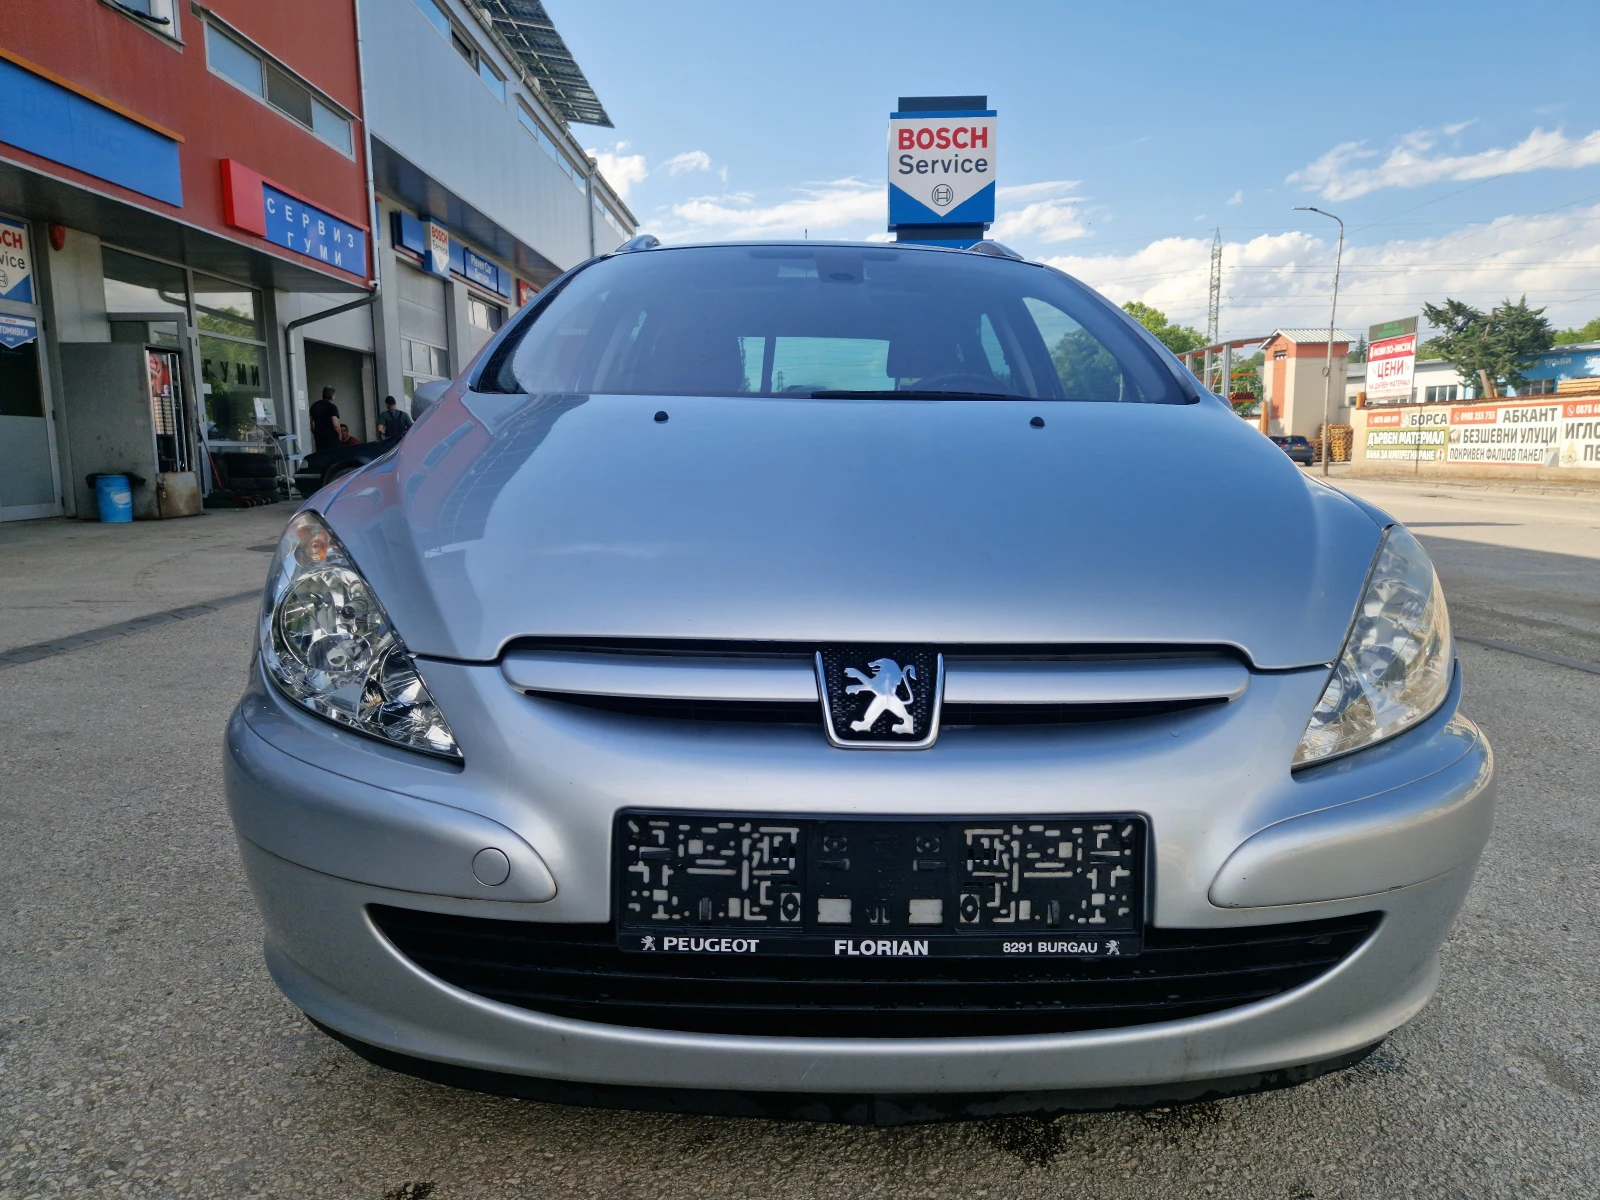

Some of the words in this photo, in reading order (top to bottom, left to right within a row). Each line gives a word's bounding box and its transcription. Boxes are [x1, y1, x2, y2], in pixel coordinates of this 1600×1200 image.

[898, 127, 988, 150] BOSCH
[898, 153, 988, 174] Service
[267, 197, 354, 248] СЕРВИЗ
[431, 226, 448, 245] BOSCH
[287, 231, 342, 266] ГУМИ
[432, 239, 449, 256] Service
[202, 358, 260, 387] ГУМИ
[1377, 360, 1404, 380] ЦЕНИ
[1411, 413, 1448, 426] БОРСА
[1502, 407, 1558, 424] АБКАНТ
[1367, 430, 1398, 448] ДЪРВЕН
[1399, 429, 1446, 446] МАТЕРИАЛ
[1463, 427, 1518, 444] БЕЗШЕВНИ
[1520, 426, 1558, 447] УЛУЦИ
[1449, 447, 1485, 461] ПОКРИВЕН
[1486, 447, 1517, 462] ФАЛЦОВ
[1518, 448, 1544, 462] ПАНЕЛ
[663, 936, 760, 953] PEUGEOT
[834, 940, 929, 956] FLORIAN
[1003, 942, 1033, 953] 8291
[1037, 942, 1098, 953] BURGAU
